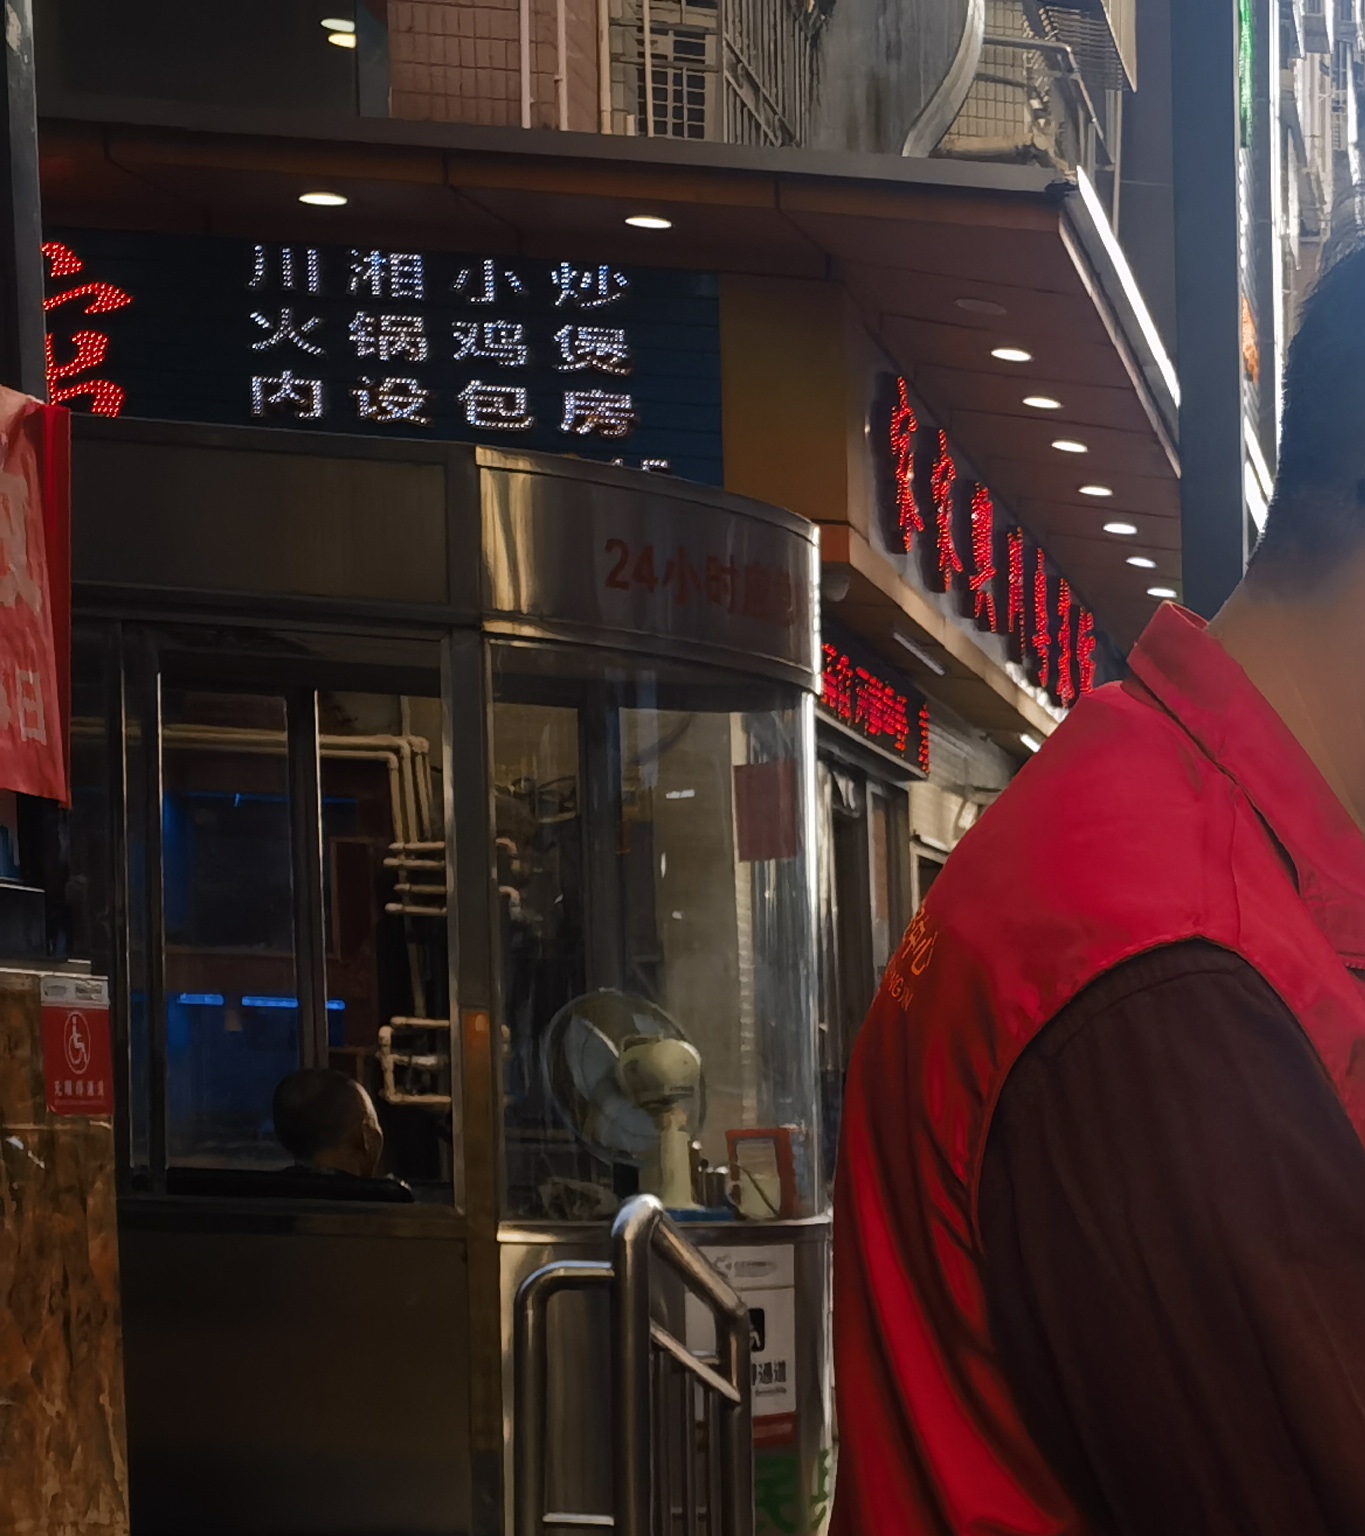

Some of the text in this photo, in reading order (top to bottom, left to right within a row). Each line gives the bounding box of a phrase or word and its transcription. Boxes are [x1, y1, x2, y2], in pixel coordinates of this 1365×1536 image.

[248, 244, 629, 306] 川湘小炒
[249, 307, 634, 375] 火锅鸡煲
[250, 370, 638, 437] 内设包房
